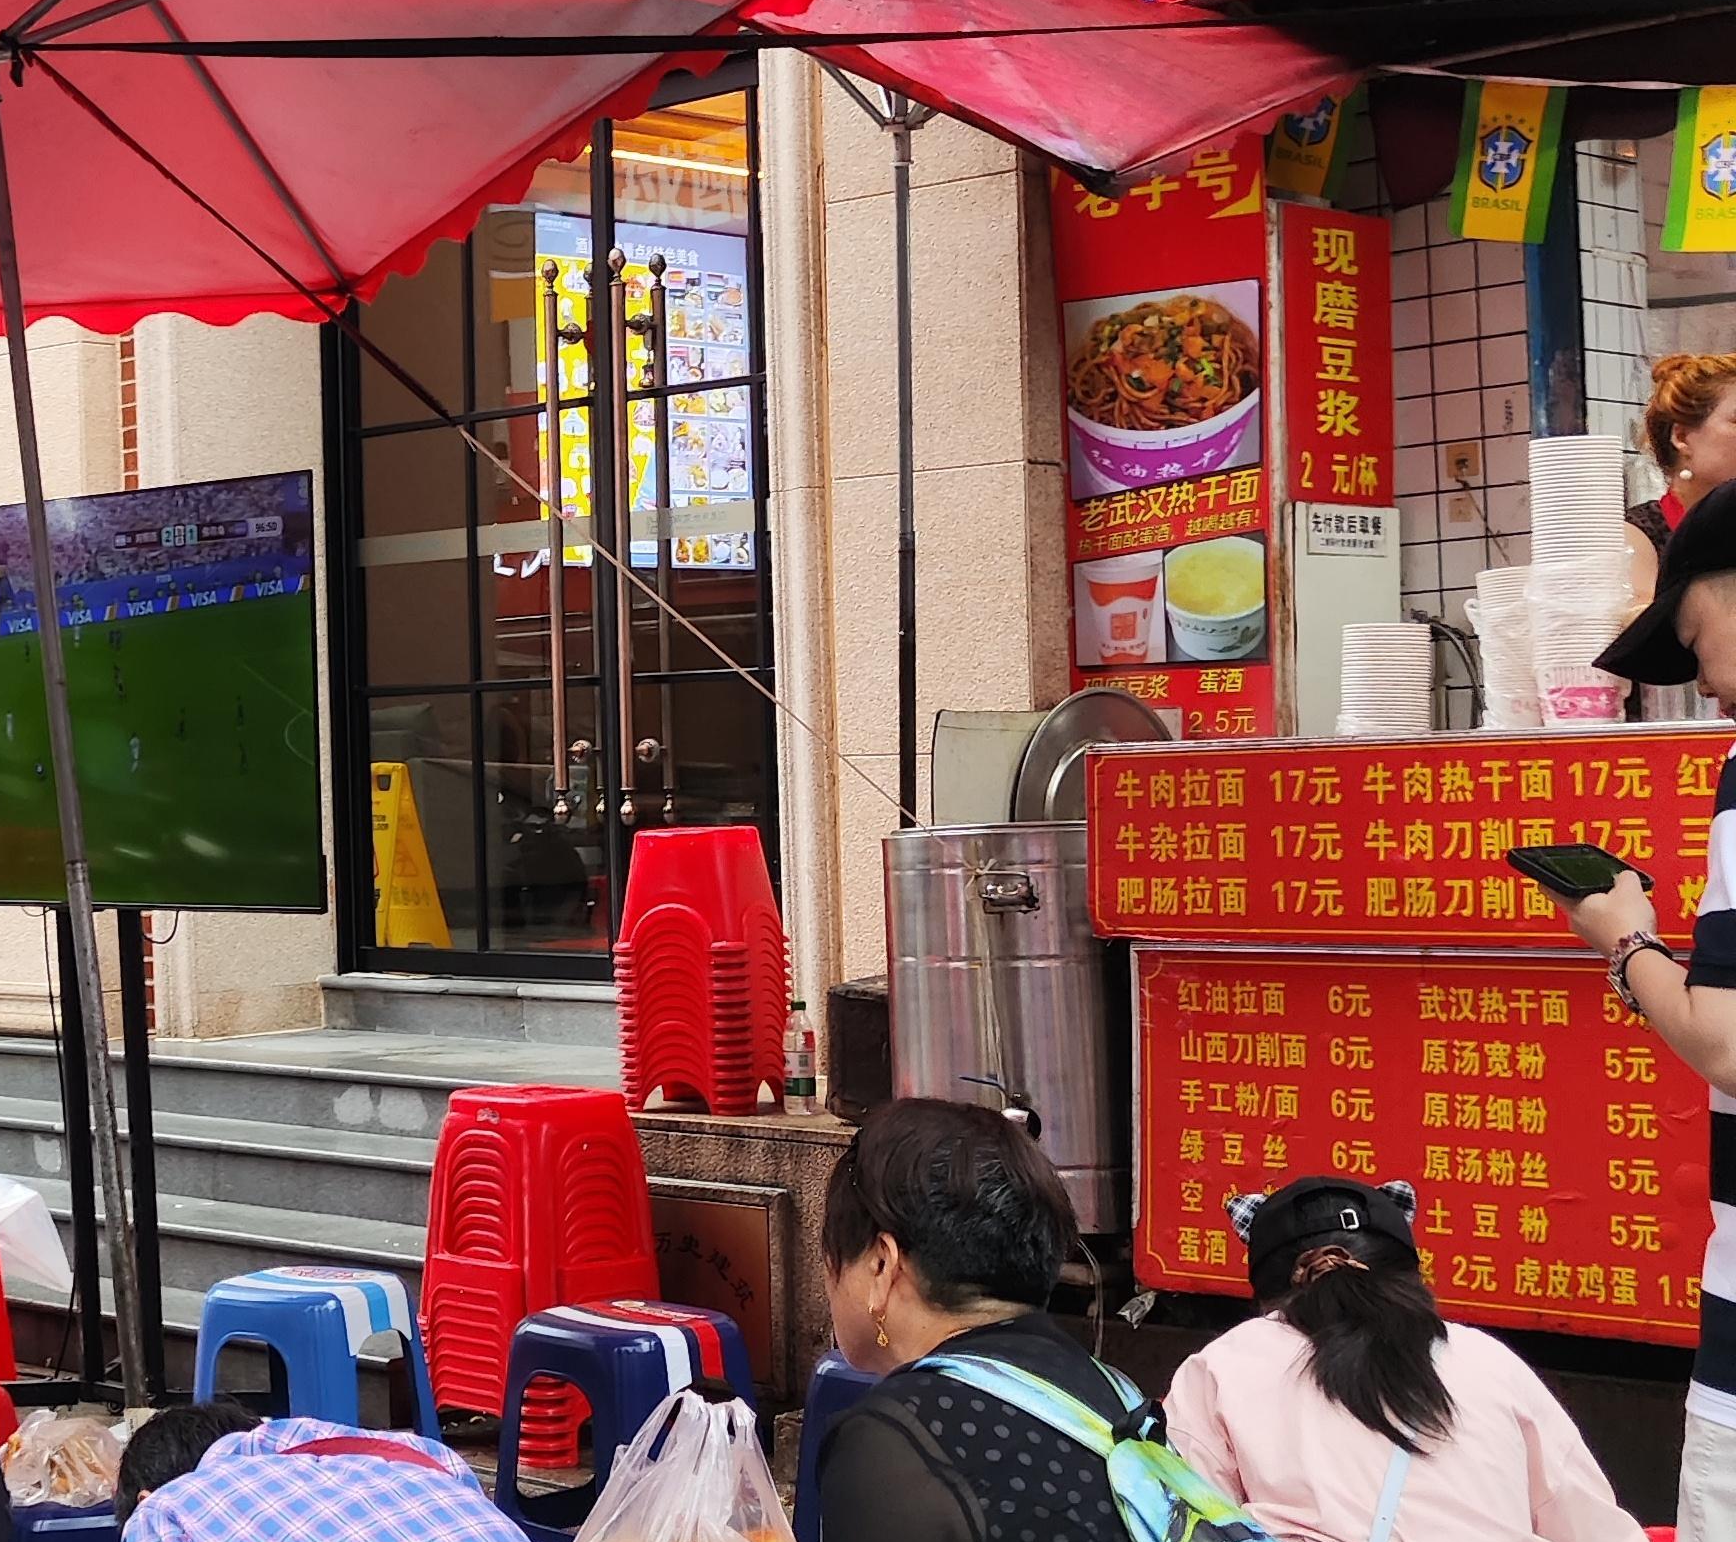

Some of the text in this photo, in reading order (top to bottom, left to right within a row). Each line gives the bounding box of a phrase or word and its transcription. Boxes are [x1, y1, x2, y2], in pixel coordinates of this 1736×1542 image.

[1470, 195, 1524, 213] BRASIL
[1312, 226, 1362, 438] 现磨豆浆
[1300, 451, 1314, 489] 2
[1079, 467, 1263, 533] 老武汉热干面
[6, 618, 33, 634] VISA
[65, 609, 93, 625] VISA
[127, 600, 155, 617] VISA
[189, 591, 217, 608] VISA
[255, 580, 284, 597] VISA
[1197, 667, 1246, 695] 蛋酒
[1188, 707, 1257, 735] 2.5元
[1115, 753, 1727, 809] 牛肉拉面 17元 牛肉热干面 17元 红
[1115, 822, 1247, 863] 牛杂拉面
[1270, 823, 1343, 861] 17元
[1364, 816, 1555, 861] 牛肉刀削面
[1569, 817, 1654, 860] 17元
[1116, 876, 1556, 921] 肥肠拉面 17元 肥肠刀削面
[1178, 980, 1286, 1017] 红油拉面
[1327, 984, 1372, 1019] 6元
[1417, 984, 1570, 1028] 武汉热干面
[1180, 1032, 1658, 1084] 山西刀削面 6元 原汤宽粉 5元
[1179, 1079, 1660, 1140] 手工粉/面 6元 原汤细粉 5元
[1179, 1127, 1661, 1196] 绿豆丝 6元 原汤粉丝 5元
[1424, 1198, 1662, 1252] 土豆粉 5元
[1177, 1226, 1228, 1266] 蛋酒
[1452, 1255, 1497, 1292] 2元
[1514, 1257, 1640, 1307] 虎皮鸡蛋
